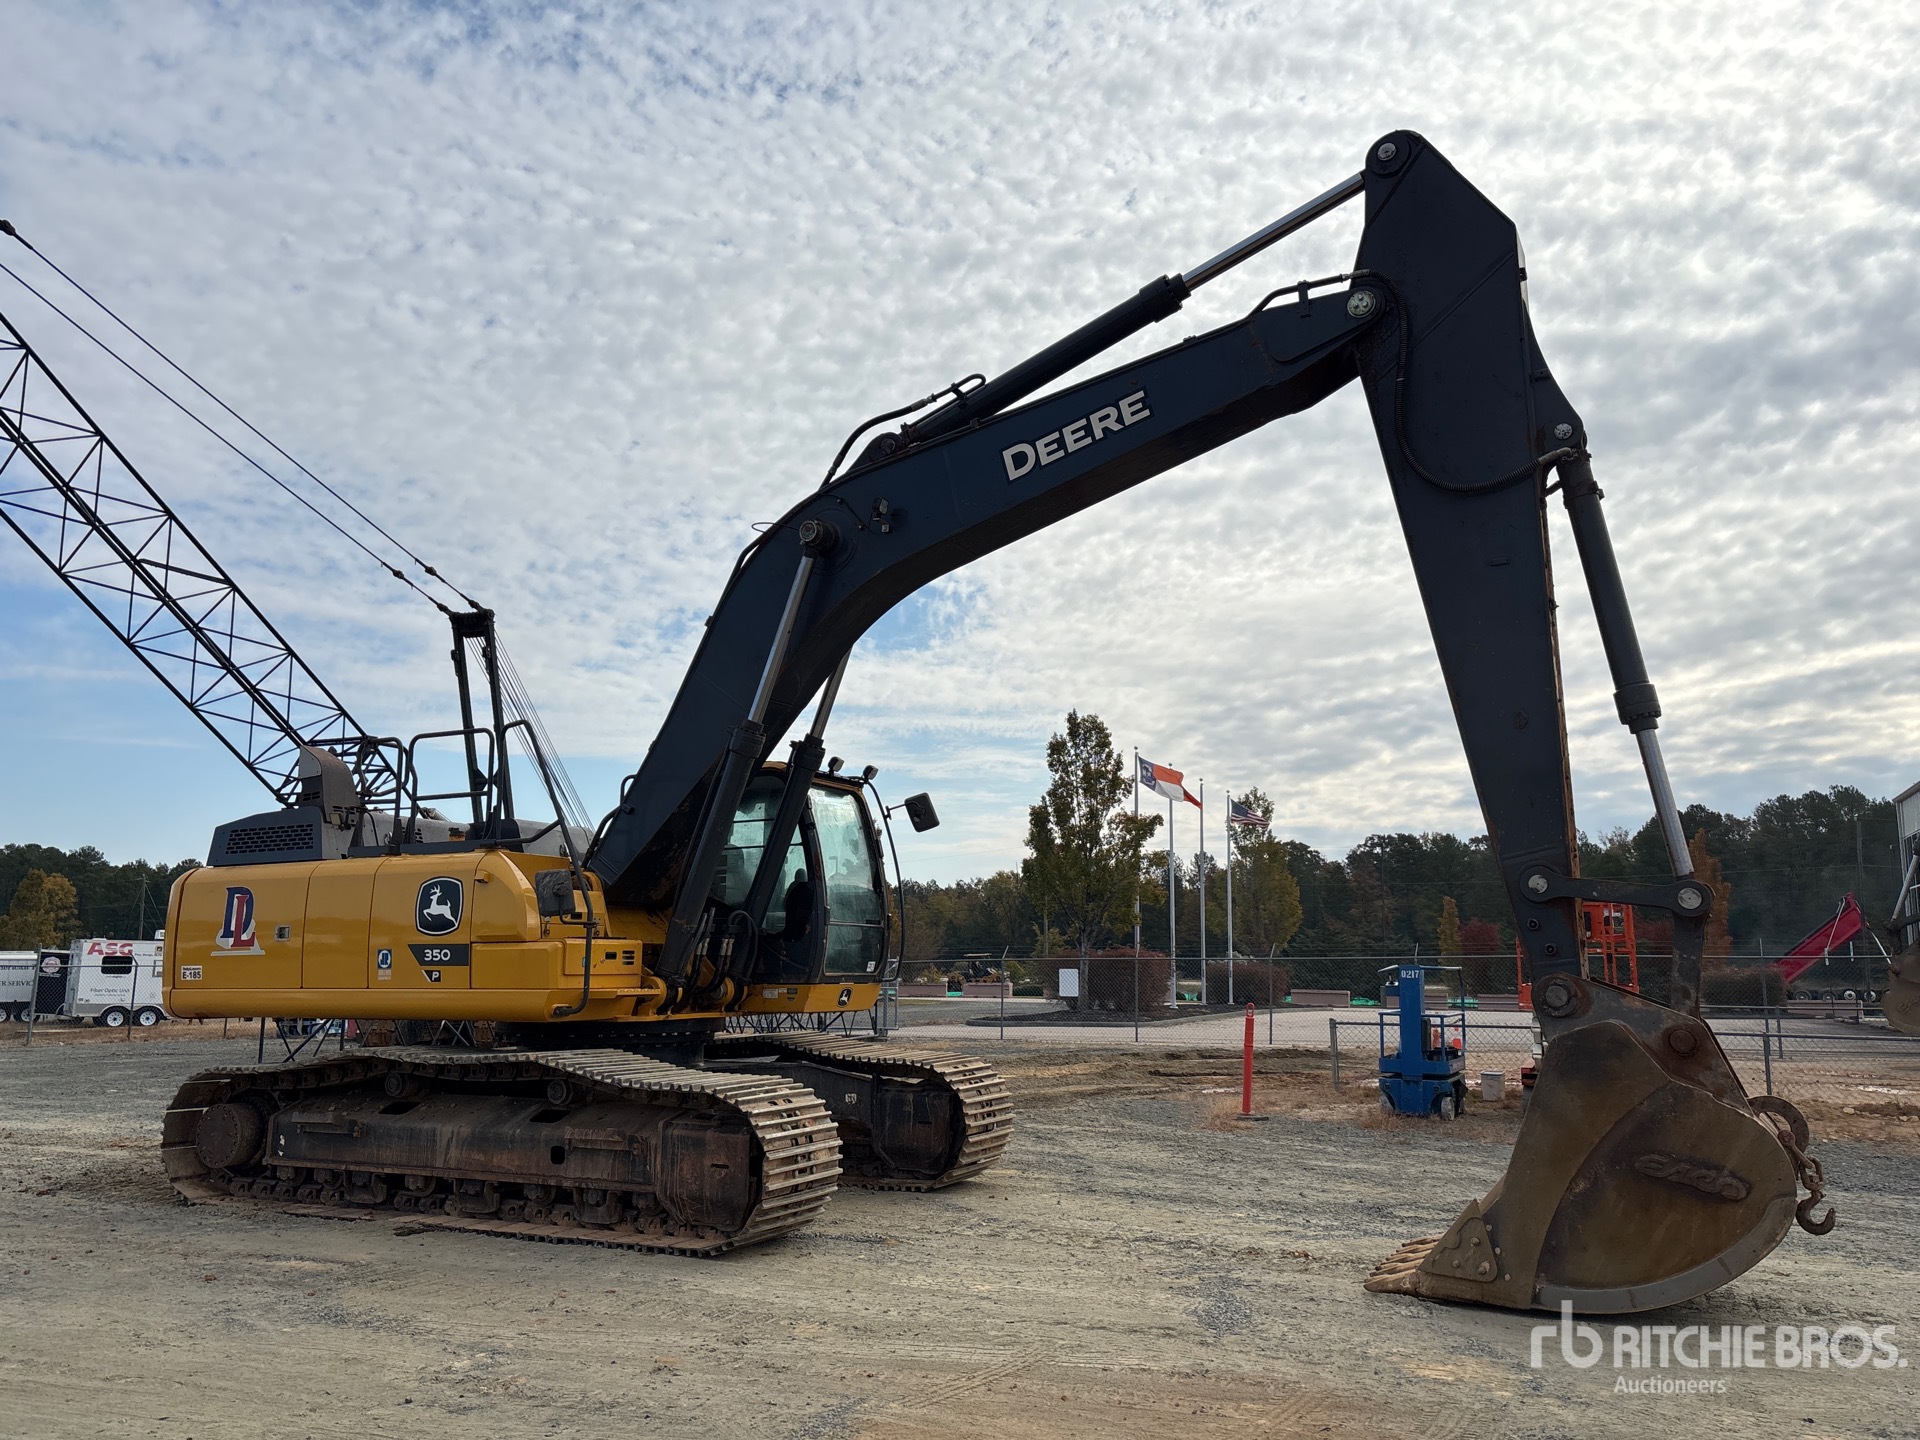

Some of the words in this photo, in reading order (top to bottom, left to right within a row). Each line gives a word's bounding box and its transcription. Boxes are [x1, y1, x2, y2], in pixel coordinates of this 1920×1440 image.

[1002, 390, 1150, 481] DEERE
[87, 942, 133, 957] ASG
[424, 949, 451, 961] 350
[182, 971, 202, 980] E-185
[431, 971, 440, 981] P
[1401, 970, 1420, 979] 0217
